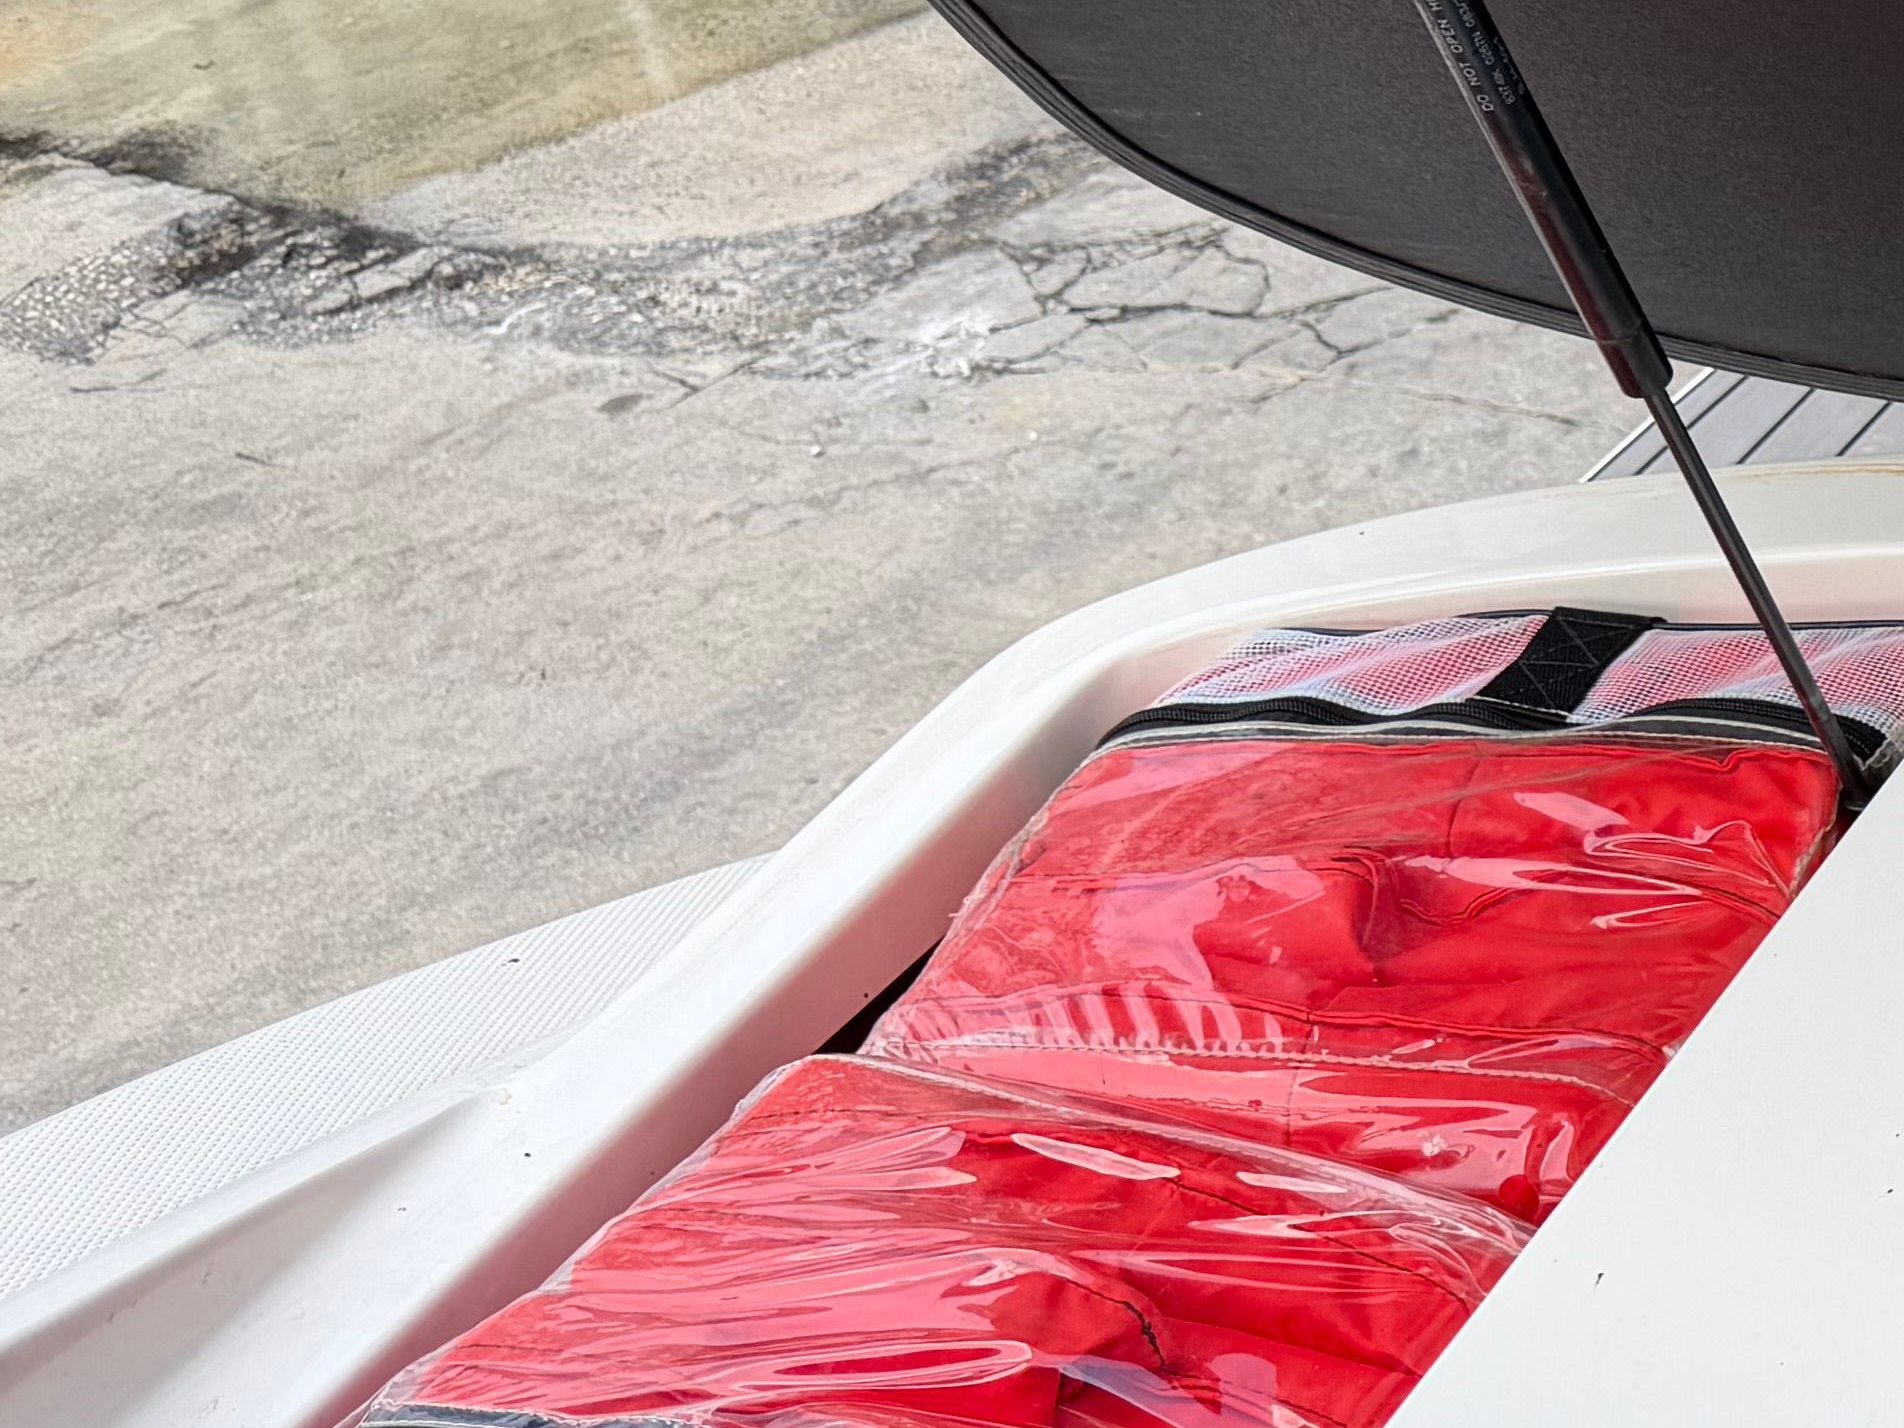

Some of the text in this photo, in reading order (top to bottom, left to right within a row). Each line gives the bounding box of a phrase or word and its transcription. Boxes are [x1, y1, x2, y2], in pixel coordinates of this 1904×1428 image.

[1437, 20, 1463, 53] OPEN
[1459, 63, 1480, 85] NOT
[1477, 95, 1494, 111] DO
